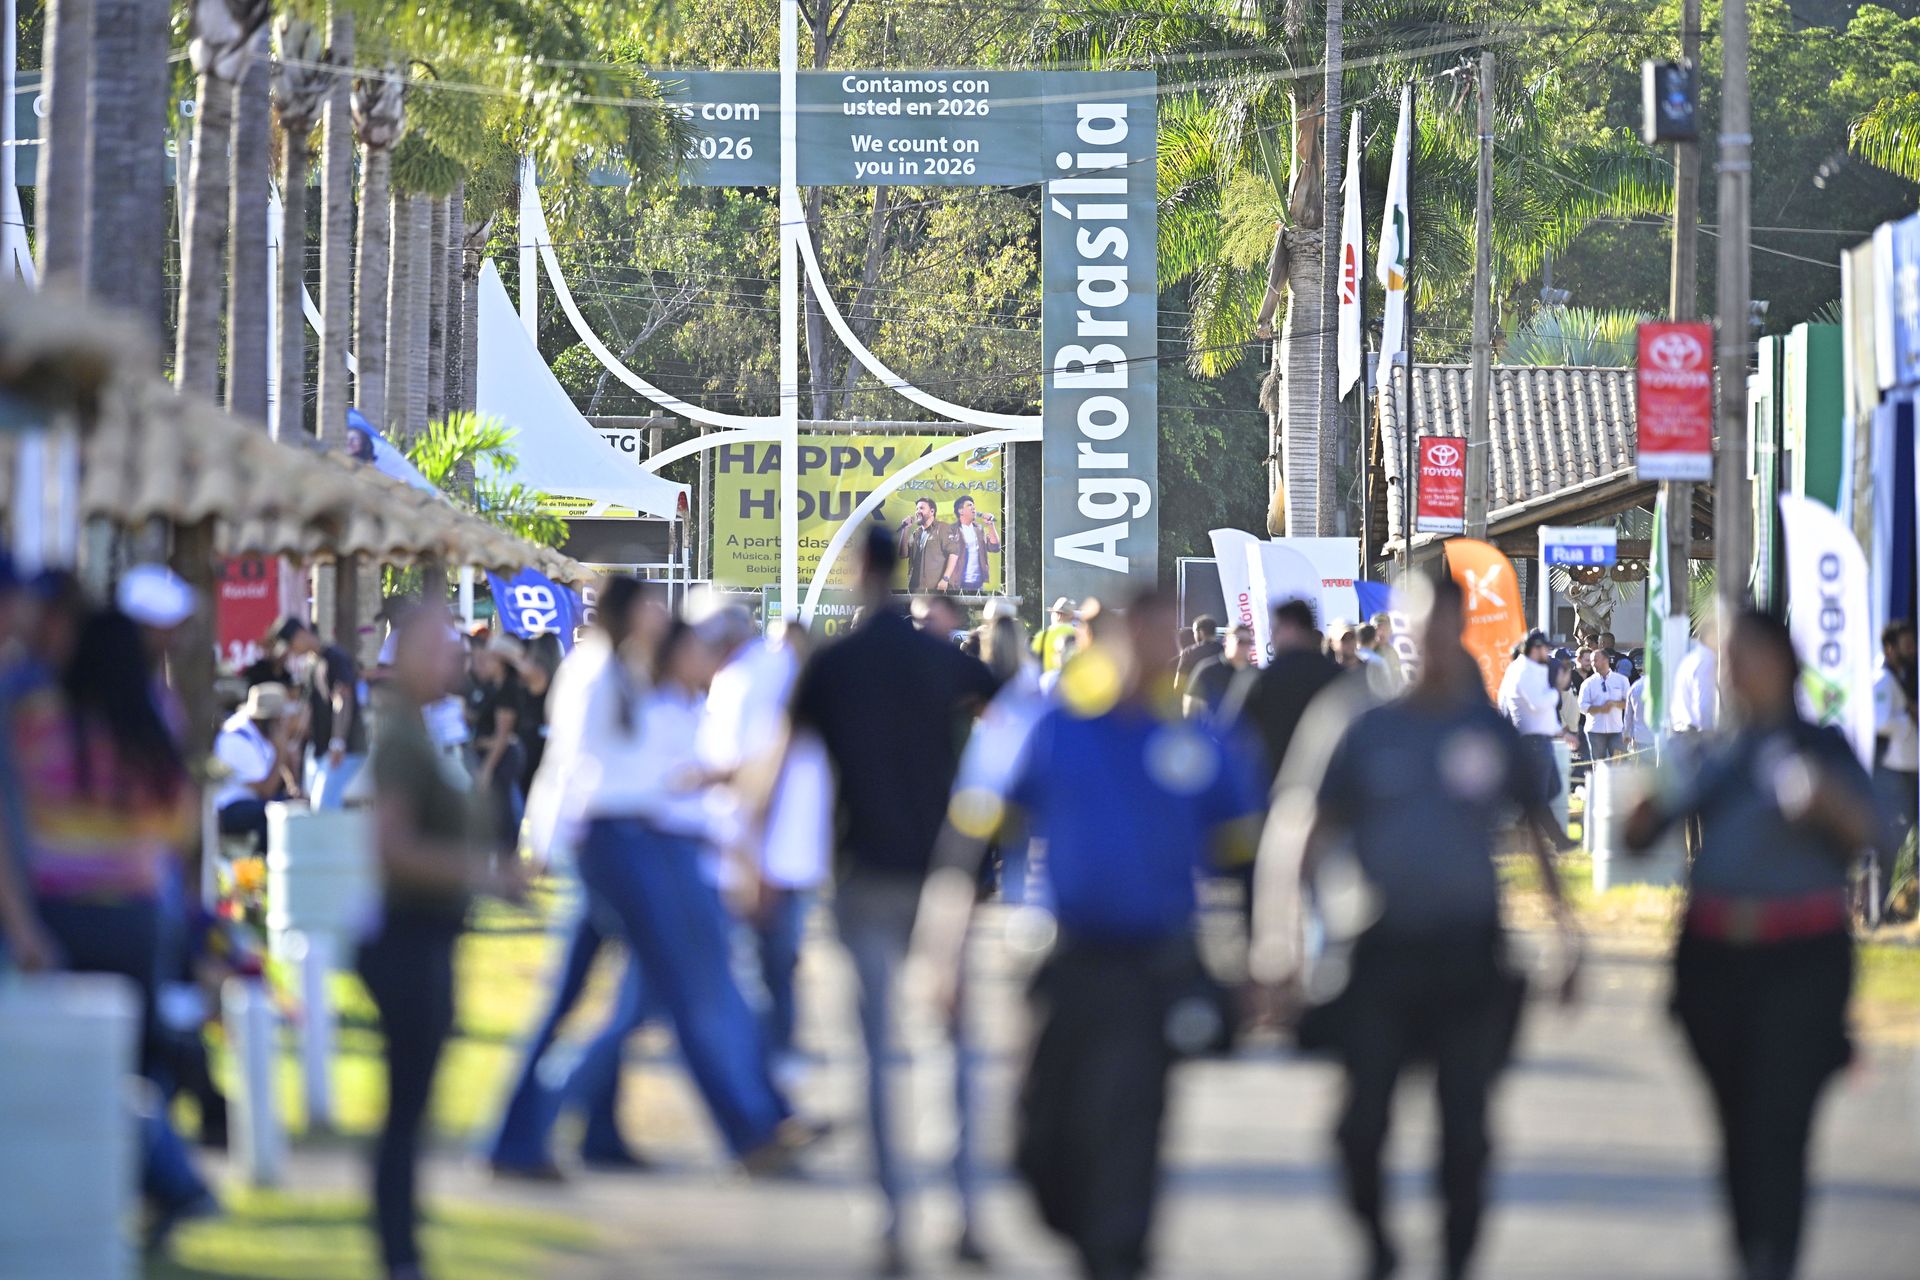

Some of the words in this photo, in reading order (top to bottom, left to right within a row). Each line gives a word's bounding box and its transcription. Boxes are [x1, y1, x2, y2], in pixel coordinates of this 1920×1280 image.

[842, 76, 947, 93] Contamos
[952, 80, 990, 93] con
[702, 102, 760, 121] com
[843, 98, 901, 116] usted
[906, 102, 932, 116] en
[937, 99, 990, 116] 2026
[851, 135, 883, 152] We
[888, 136, 948, 152] count
[952, 139, 980, 152] on
[854, 161, 894, 179] you
[899, 157, 919, 175] in
[923, 158, 976, 175] 2026
[1049, 102, 1152, 574] AgroBrasília
[719, 443, 895, 477] HAPPY
[1423, 467, 1463, 477] TOYOTA
[726, 534, 739, 546] A
[1552, 546, 1584, 562] Rua
[1592, 546, 1605, 562] B
